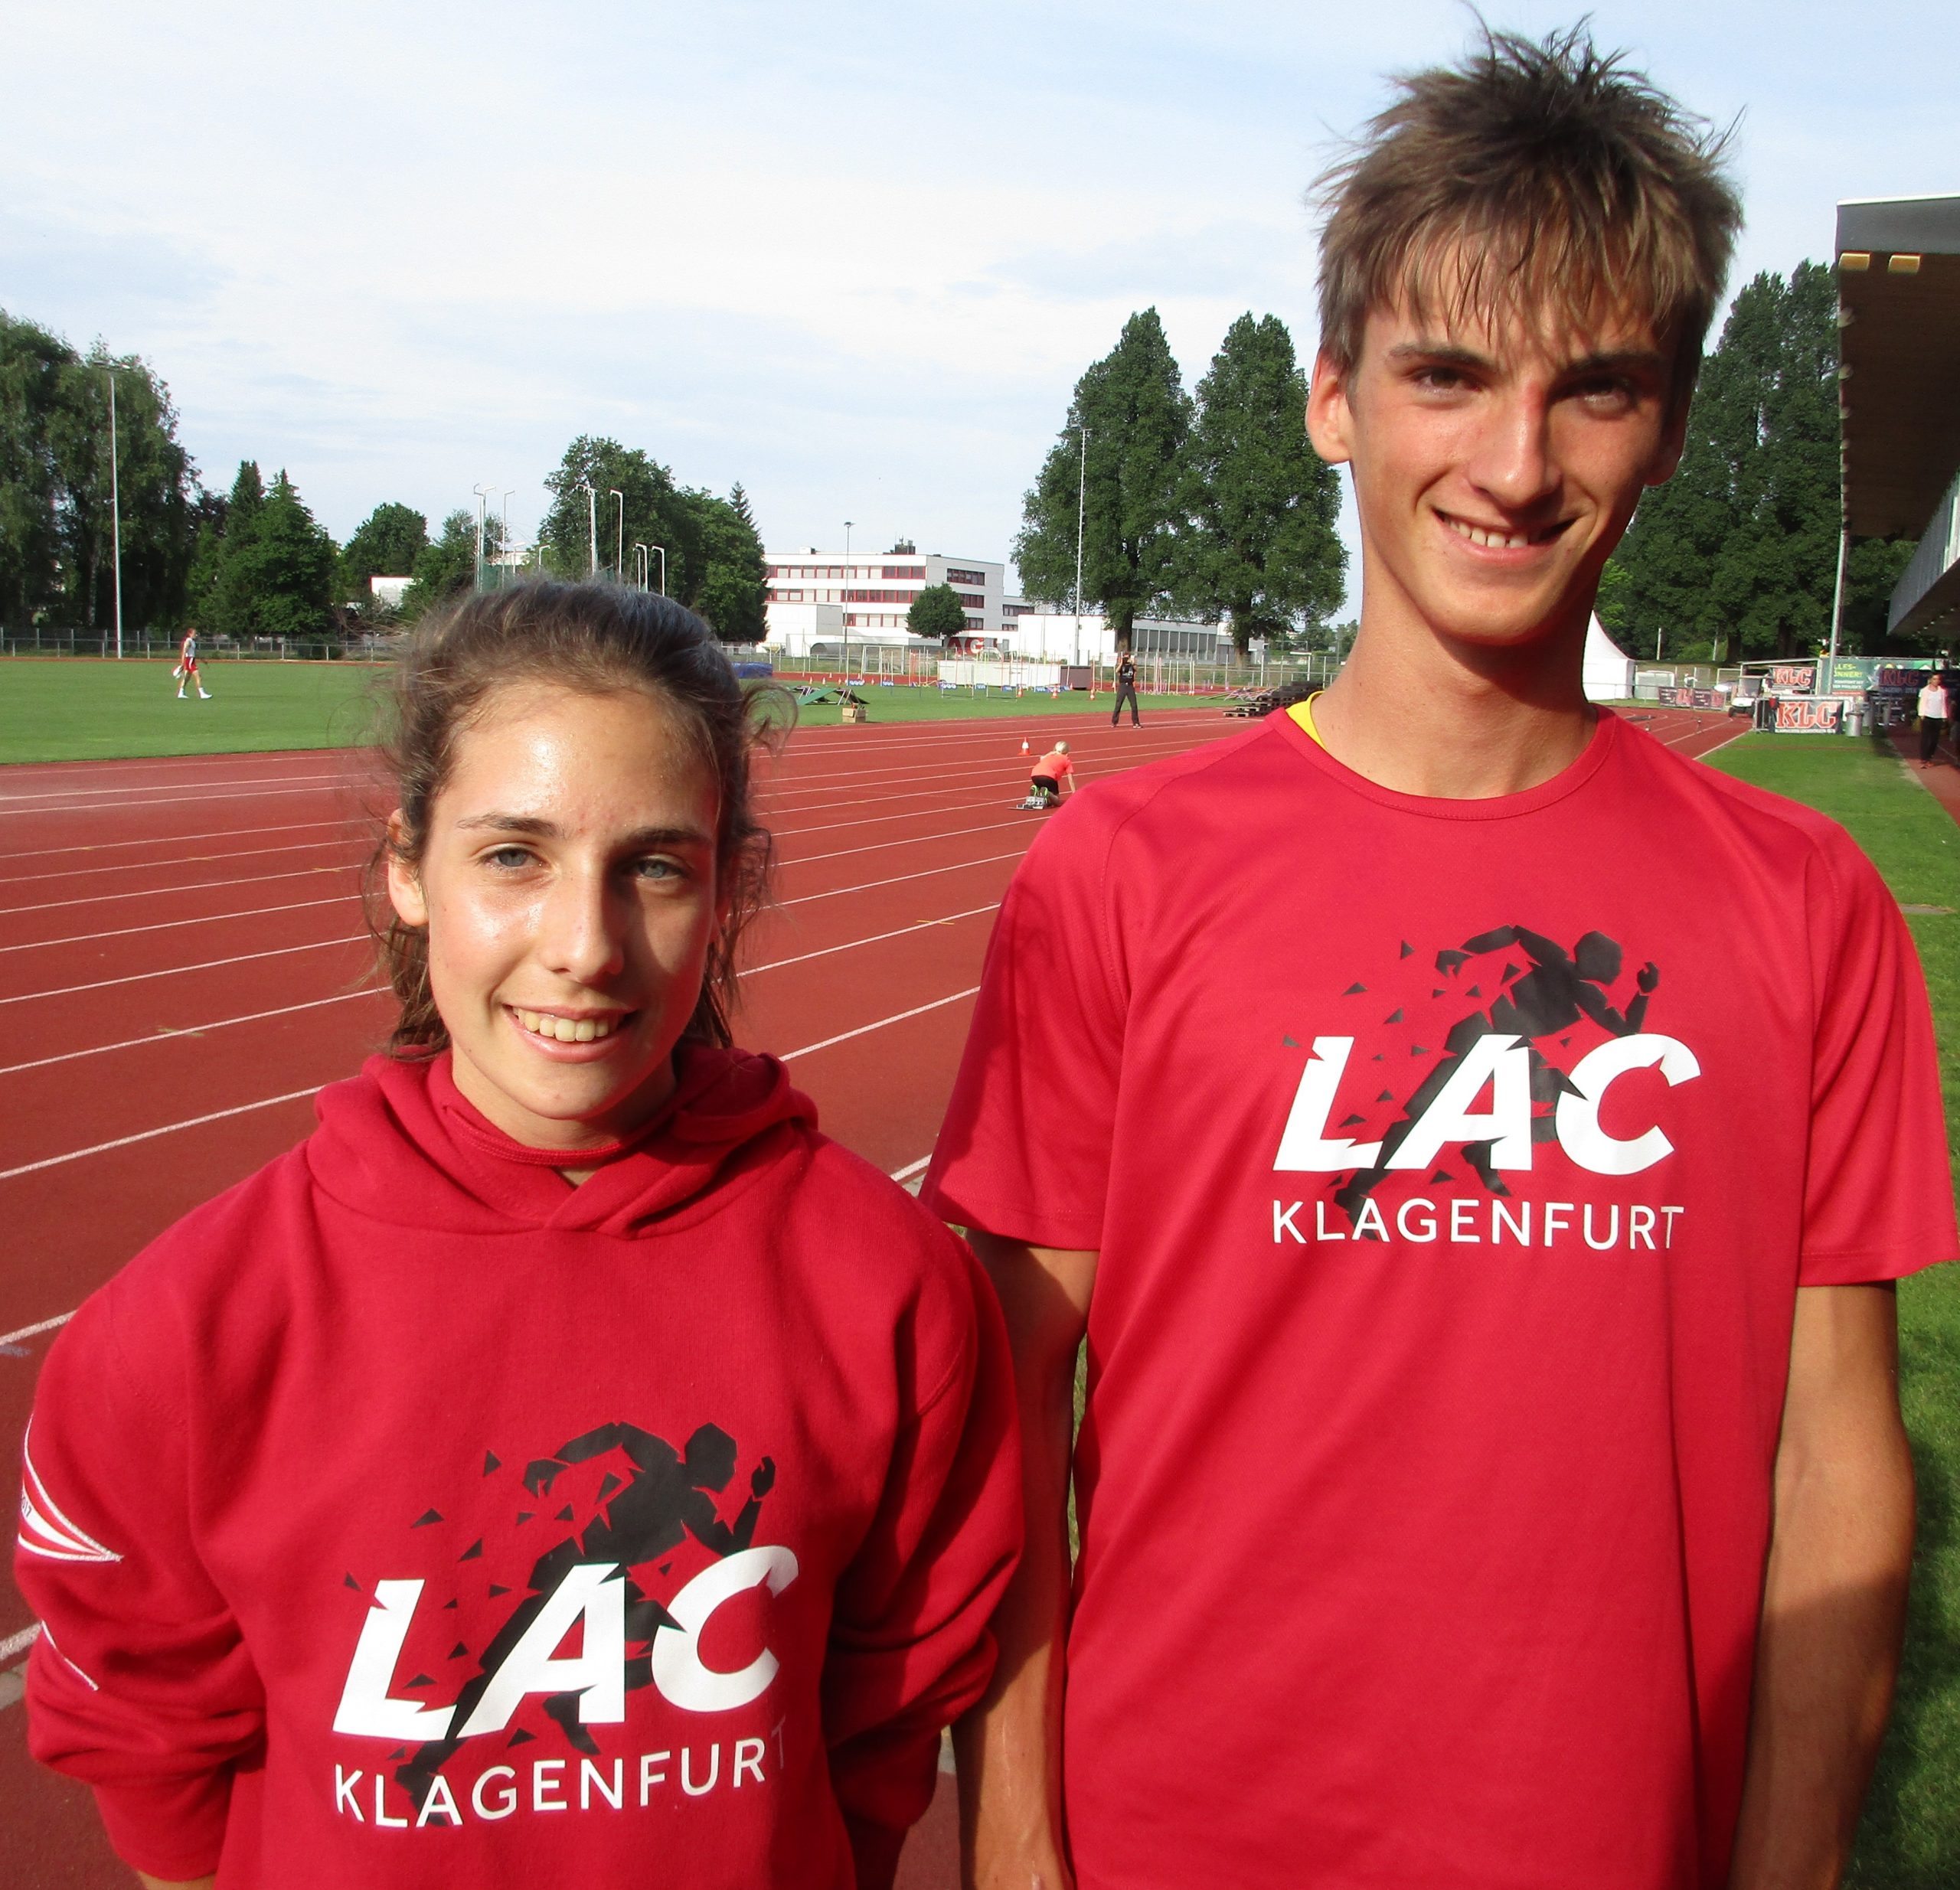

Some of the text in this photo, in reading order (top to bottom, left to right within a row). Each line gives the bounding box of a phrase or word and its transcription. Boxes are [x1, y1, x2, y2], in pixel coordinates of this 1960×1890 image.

[1774, 668, 1812, 686] KLC
[1775, 701, 1837, 729] KLC
[1272, 1033, 1701, 1175] LAC
[1272, 1197, 1684, 1250] KLAGENFURT
[332, 1545, 799, 1741] LAC
[334, 1714, 786, 1828] KLAGENFURT
